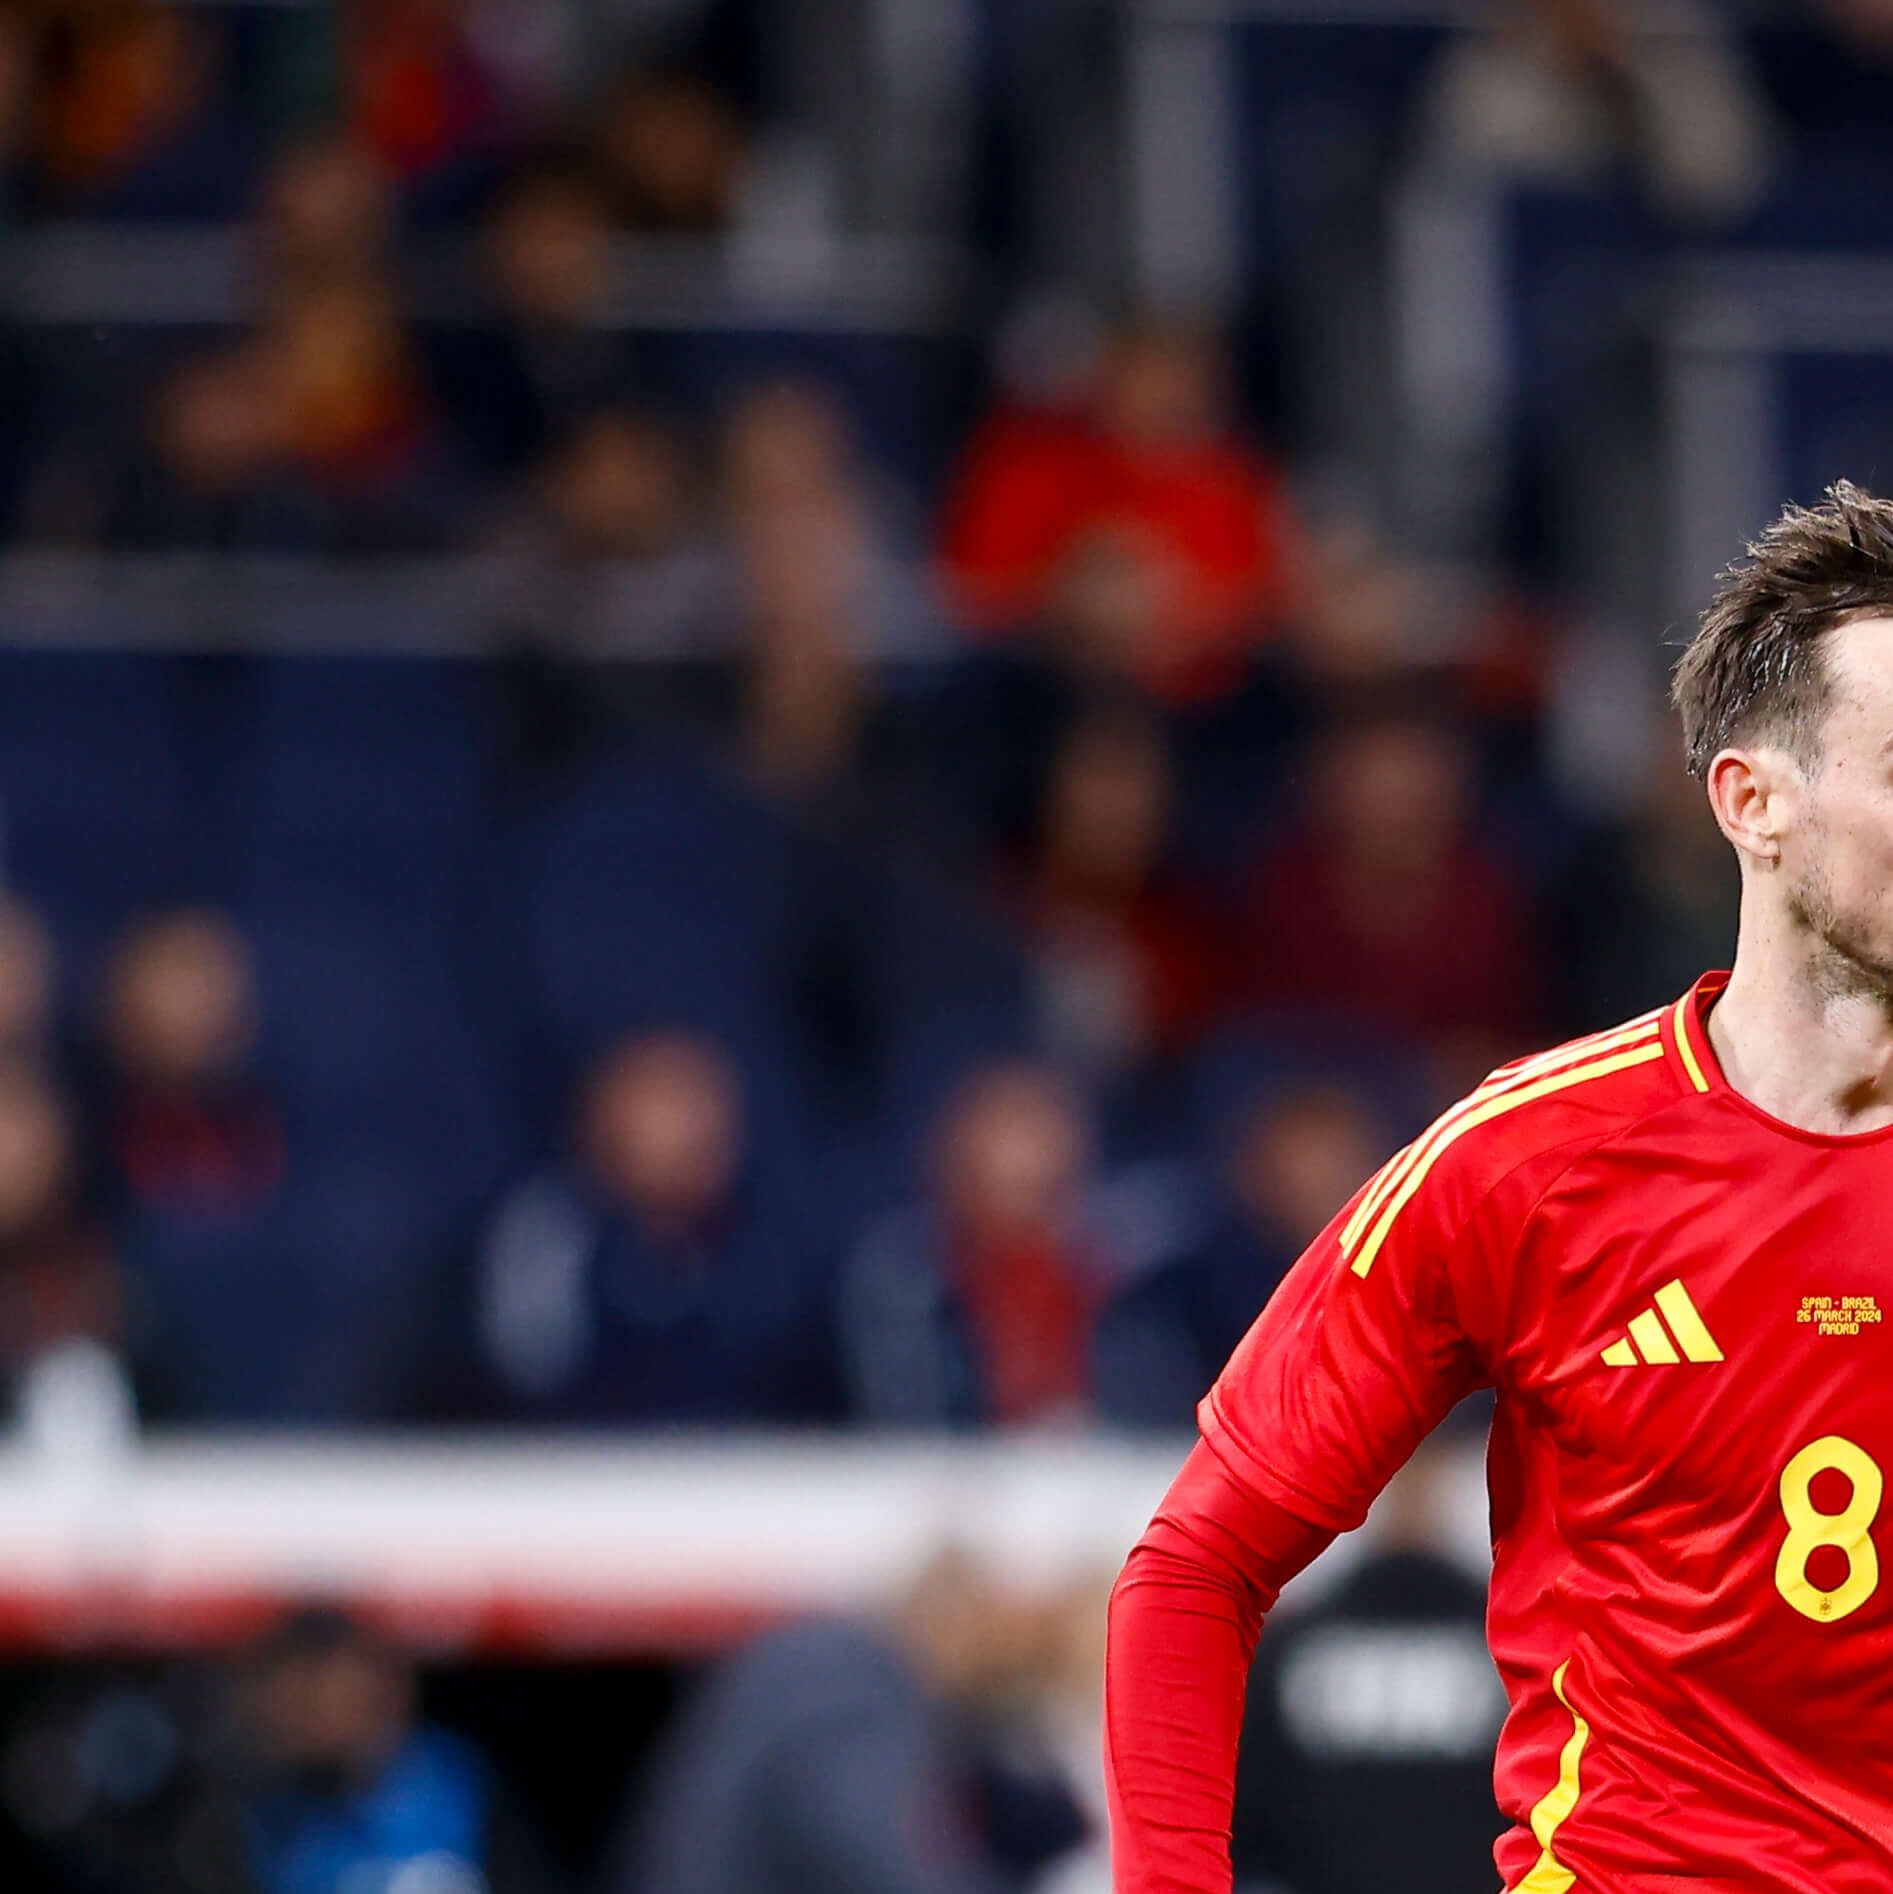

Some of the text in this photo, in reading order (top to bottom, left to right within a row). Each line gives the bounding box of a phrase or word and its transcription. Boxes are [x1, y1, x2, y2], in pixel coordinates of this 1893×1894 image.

[1801, 1296, 1832, 1310] SPAIN
[1841, 1296, 1877, 1310] BRAZIL
[1796, 1310, 1882, 1323] 26 MARCH 2024
[1818, 1322, 1860, 1335] MADRID
[1775, 1435, 1883, 1623] 8
